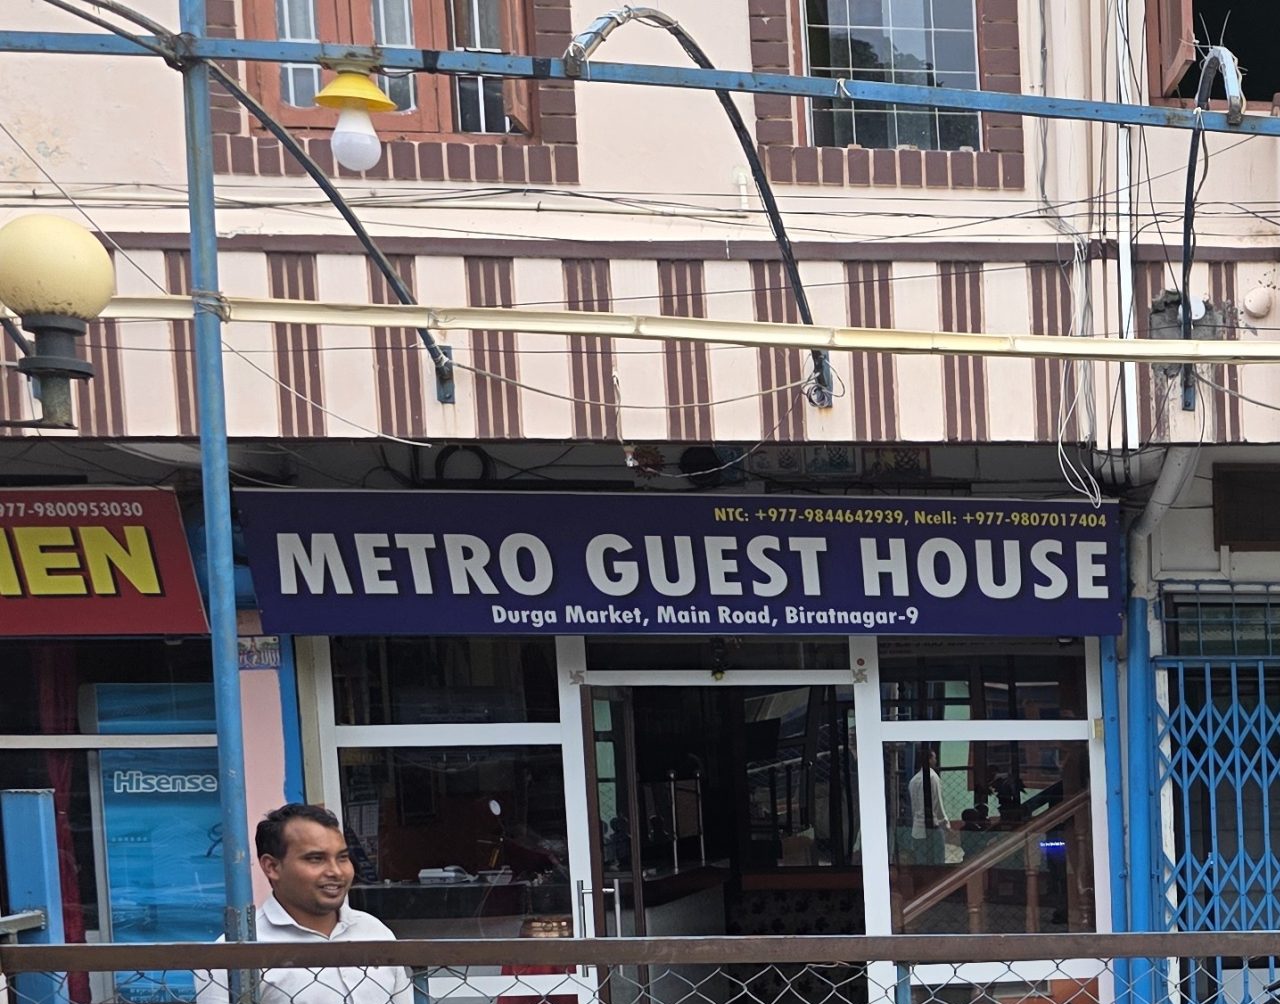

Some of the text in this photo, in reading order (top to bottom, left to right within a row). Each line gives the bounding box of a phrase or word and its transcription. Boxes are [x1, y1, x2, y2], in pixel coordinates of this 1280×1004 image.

[714, 508, 1106, 527] NTC: +977-9844642939, Ncell: +977-9807017404
[277, 533, 1109, 599] METRO GUEST HOUSE
[491, 605, 919, 628] Durga Market, Main Road, Biratnagar-9
[114, 770, 218, 793] Hisense
